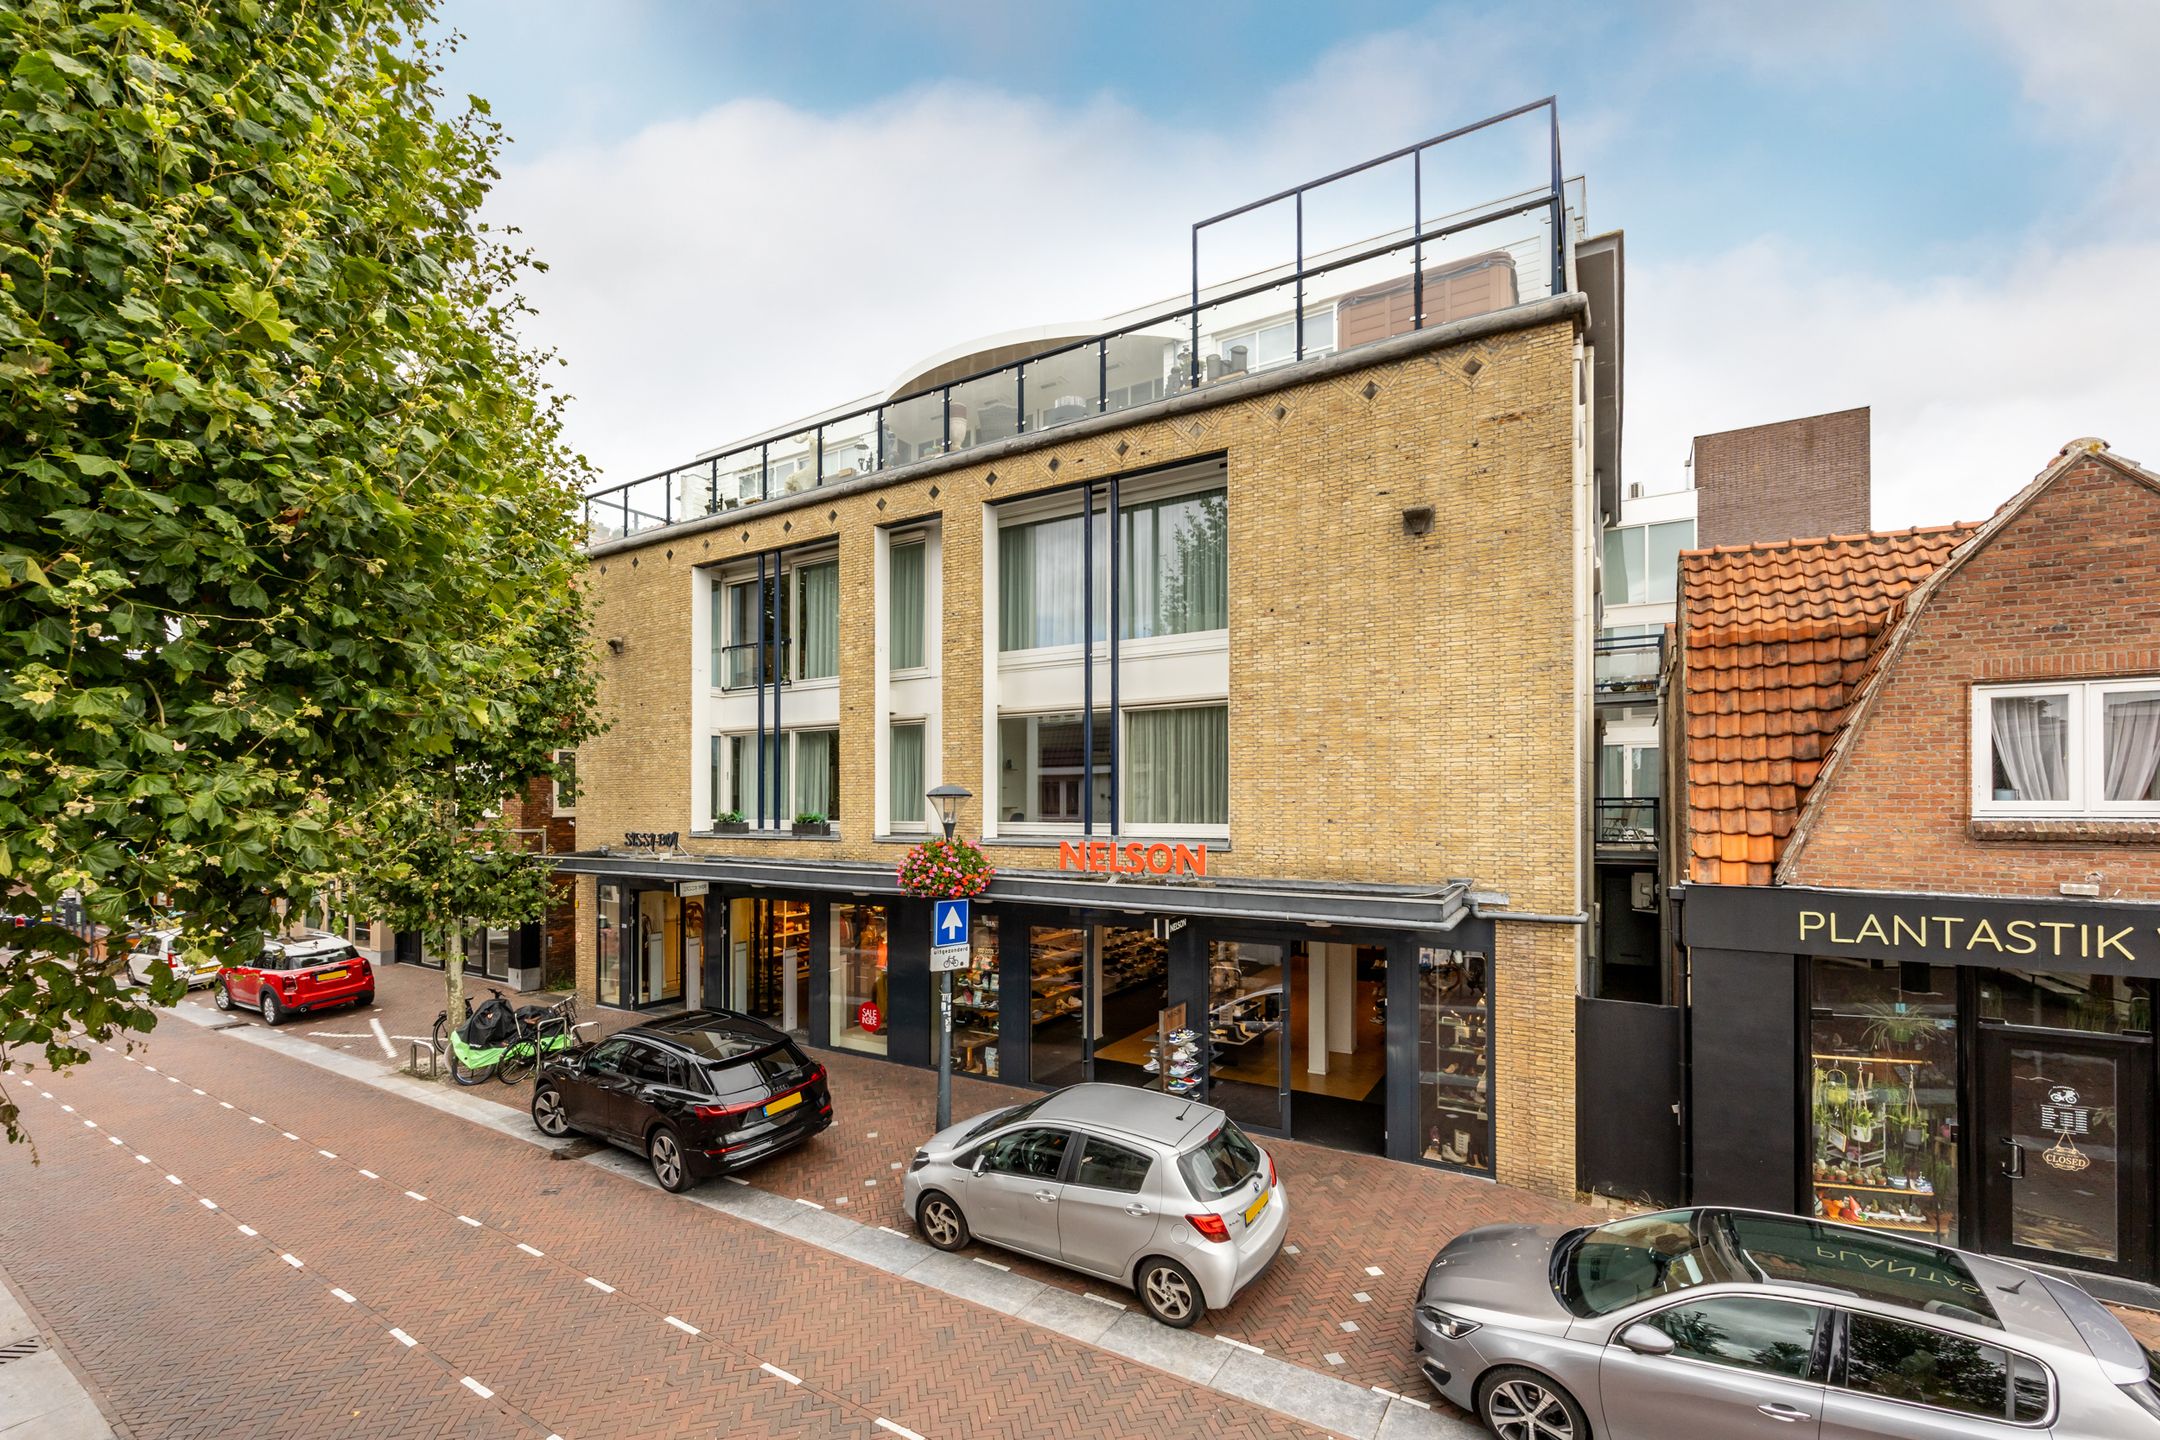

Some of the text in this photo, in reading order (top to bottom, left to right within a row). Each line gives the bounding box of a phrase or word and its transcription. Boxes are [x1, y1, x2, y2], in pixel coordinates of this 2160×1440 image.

[1059, 841, 1207, 876] NELSON
[1170, 918, 1187, 932] NELSON
[1799, 911, 2136, 961] PLANTASTIK
[933, 946, 969, 955] uitgezonderd
[862, 1007, 877, 1017] SALE
[2046, 1154, 2087, 1167] CLOSED
